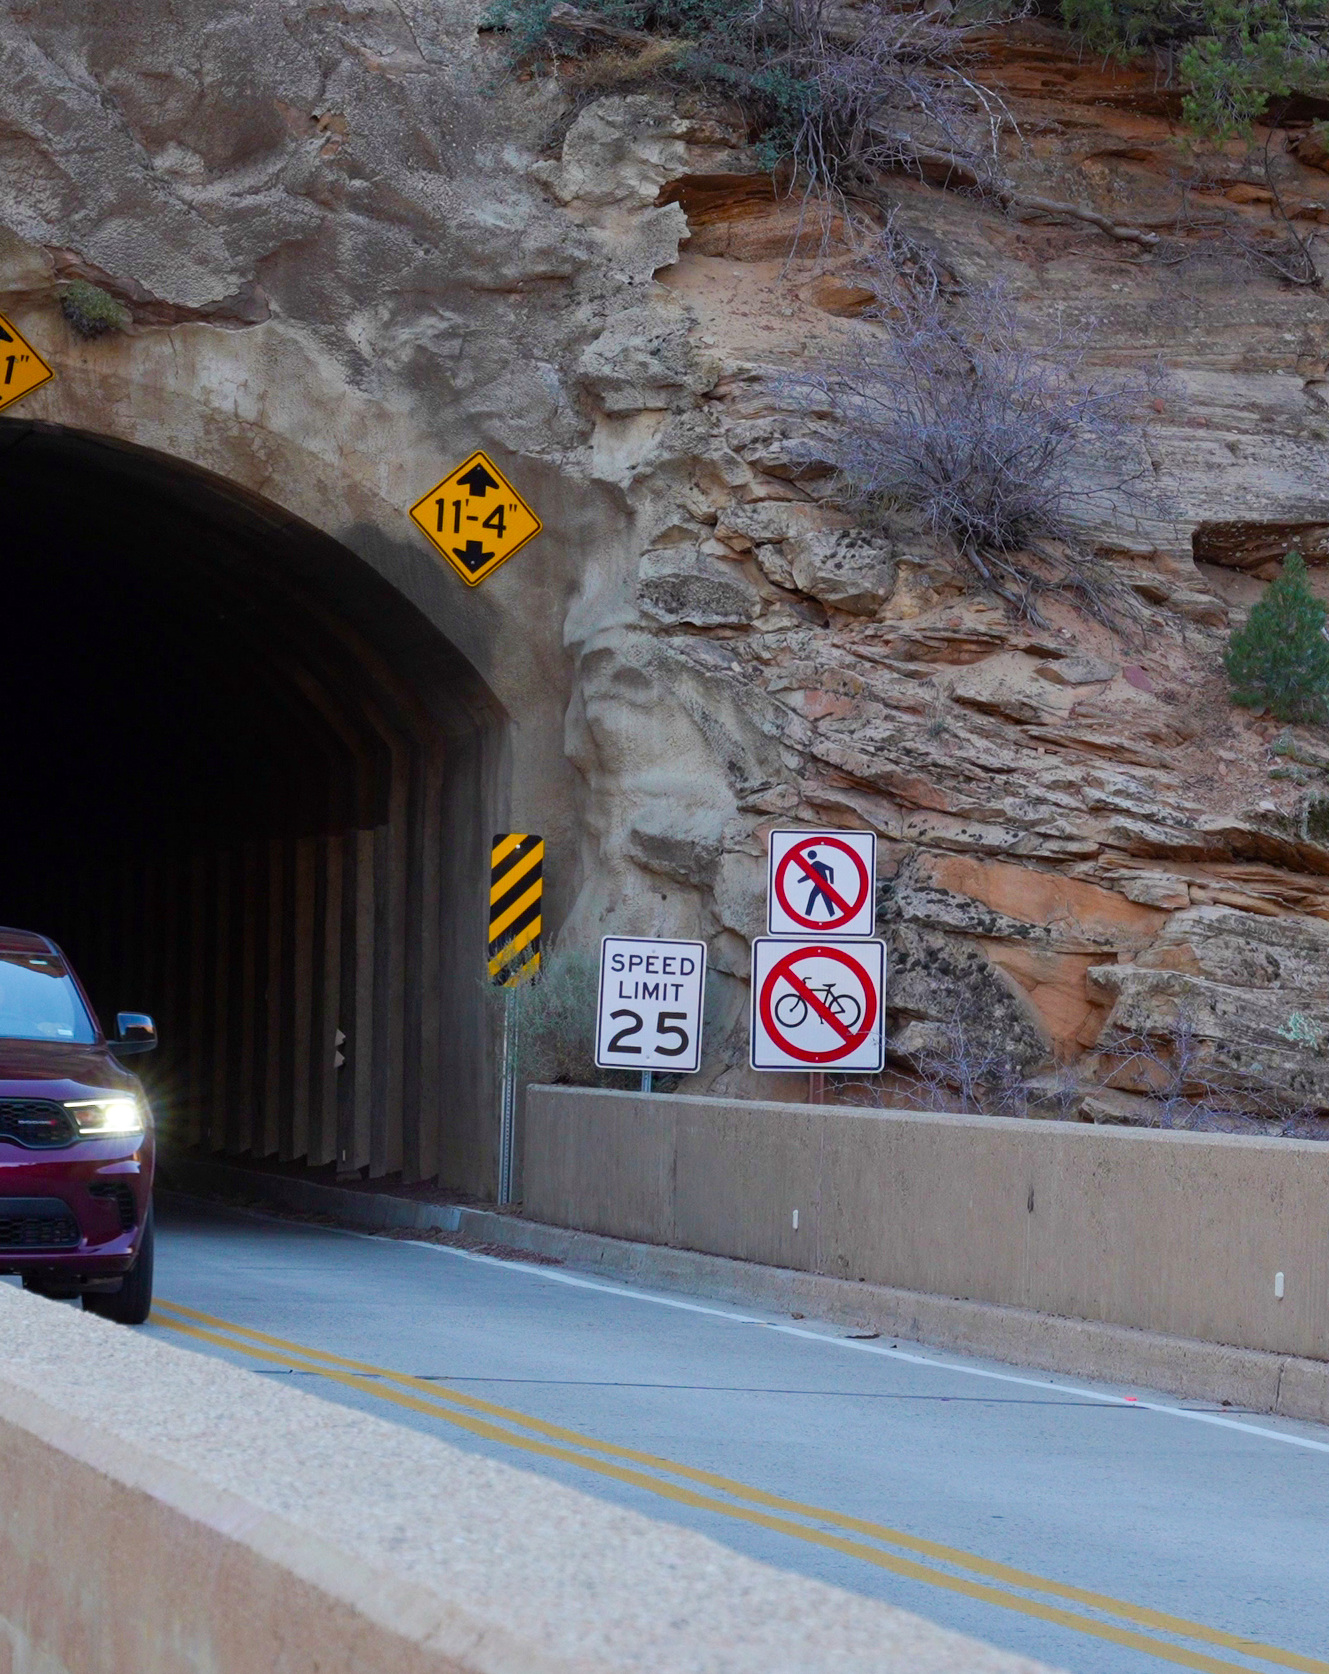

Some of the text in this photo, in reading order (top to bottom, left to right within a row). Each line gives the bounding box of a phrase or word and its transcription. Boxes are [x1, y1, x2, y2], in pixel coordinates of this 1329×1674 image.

[435, 498, 518, 539] 11'-4"
[610, 953, 695, 976] SPEED
[618, 980, 684, 1002] LIMIT
[607, 1008, 689, 1056] 25
